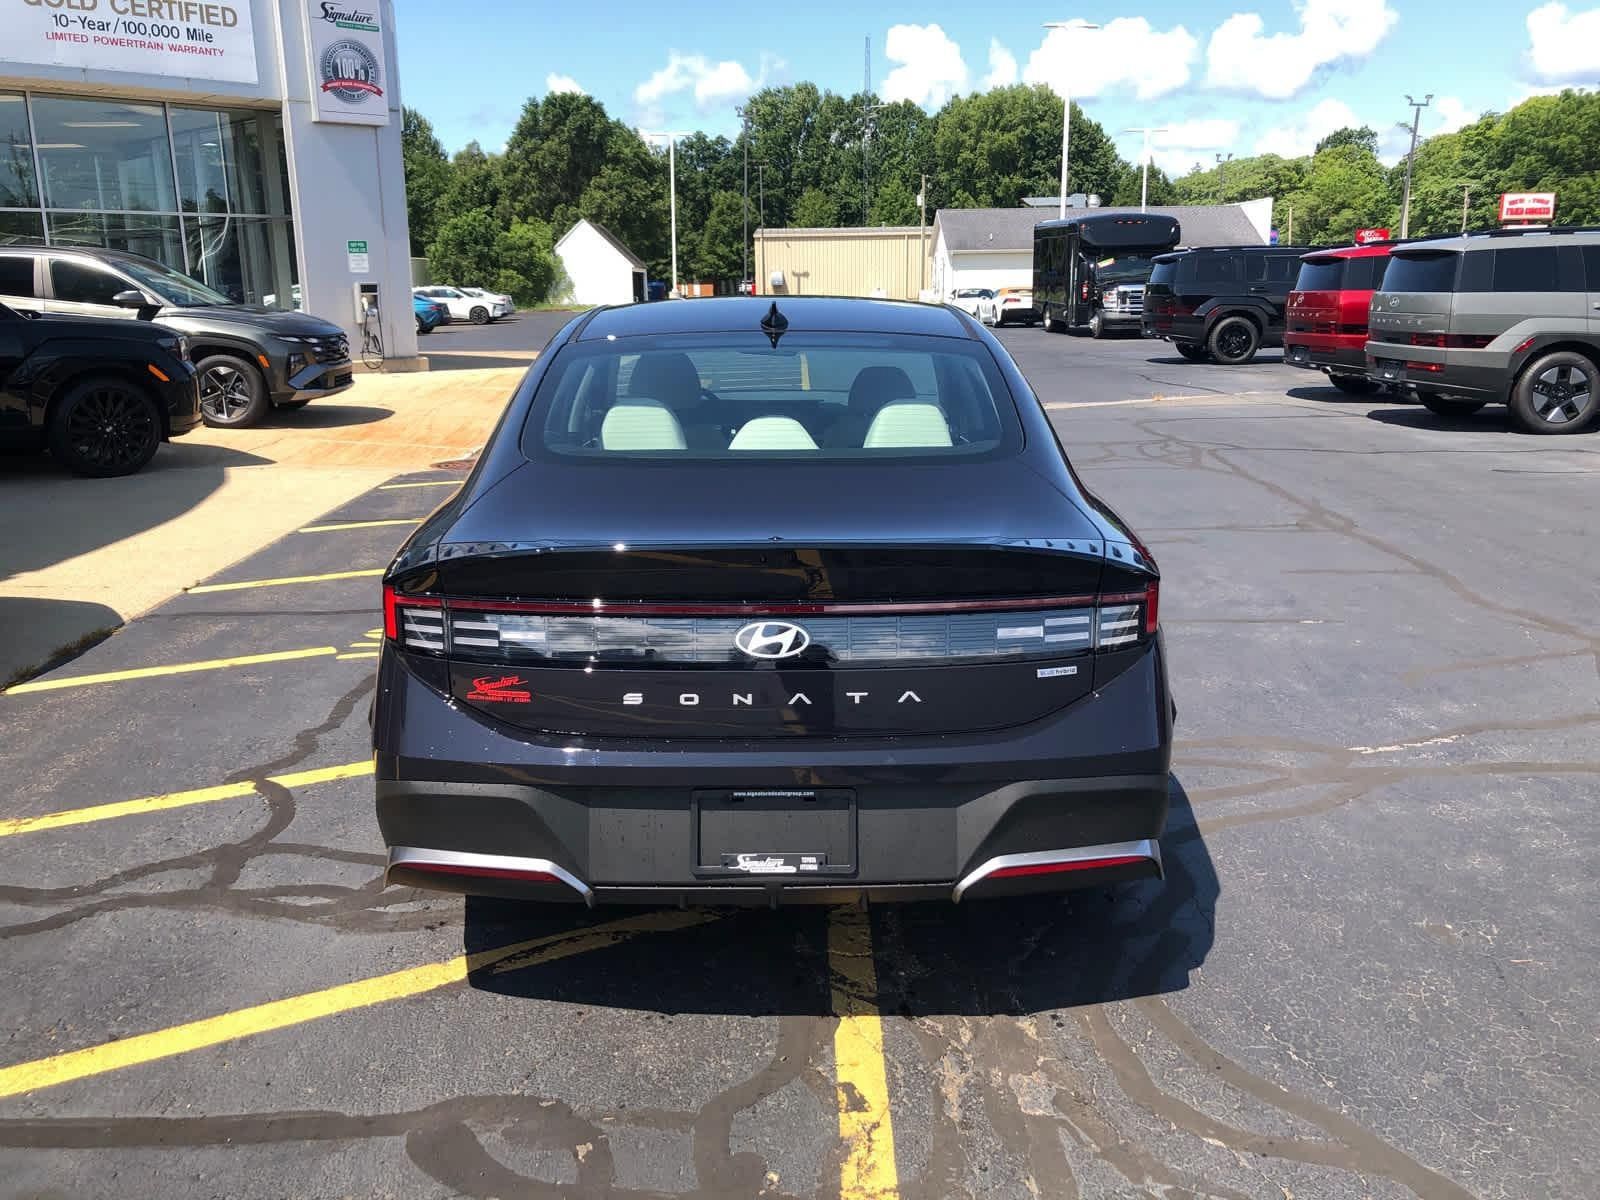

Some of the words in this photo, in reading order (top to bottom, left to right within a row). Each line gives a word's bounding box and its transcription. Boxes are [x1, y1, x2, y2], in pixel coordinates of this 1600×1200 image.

[110, 0, 238, 28] CERTIFIED
[314, 1, 376, 23] Signature
[45, 31, 89, 43] LIMITED
[93, 35, 164, 51] POWERTRAIN
[168, 43, 225, 57] WARRANTY
[186, 27, 214, 43] Mile
[335, 56, 366, 81] 100%
[470, 675, 528, 693] Signature
[622, 690, 923, 706] SONATA
[728, 853, 785, 871] Signature
